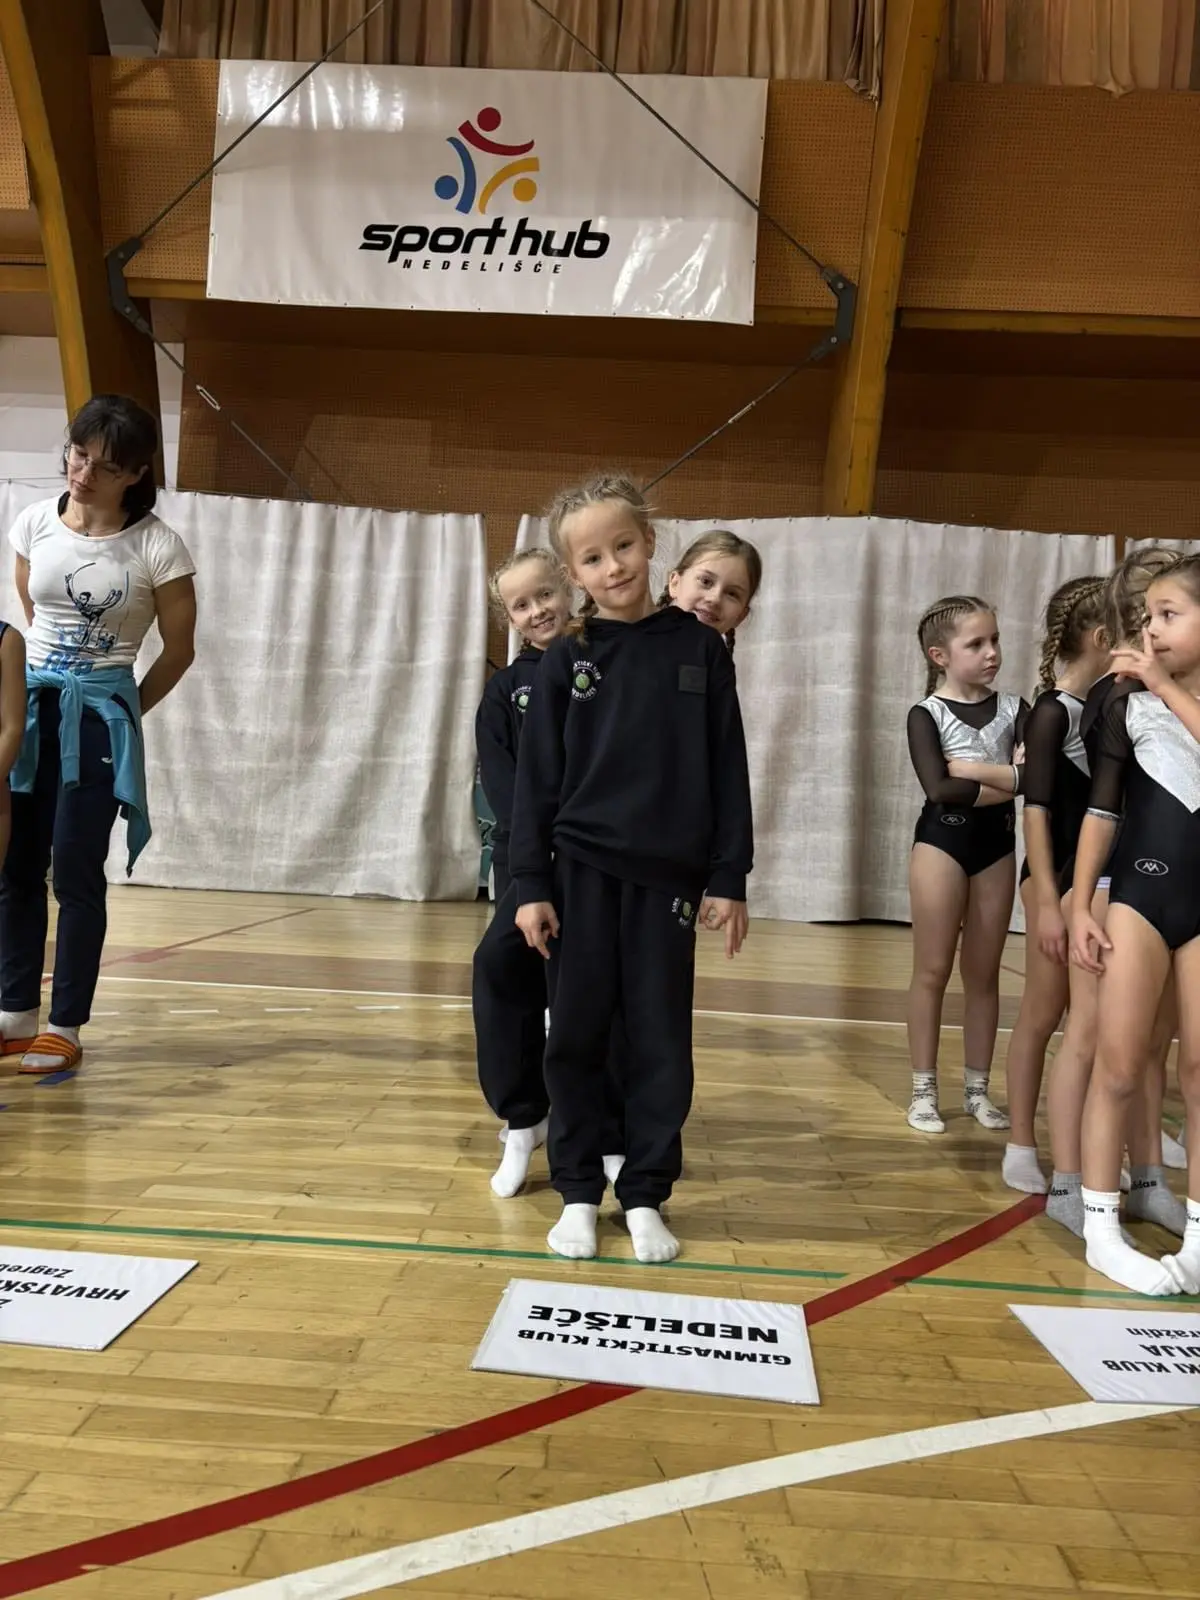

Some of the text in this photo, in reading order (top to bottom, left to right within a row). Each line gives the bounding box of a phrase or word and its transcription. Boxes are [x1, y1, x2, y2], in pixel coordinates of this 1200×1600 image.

[402, 259, 562, 274] NEDELIŠĆE
[0, 1280, 130, 1300] HRVATSK
[528, 1305, 779, 1344] NEDELIŠĆE
[1125, 1327, 1200, 1340] raždin
[517, 1329, 791, 1366] GIMNASTIČKI KLUB
[1102, 1360, 1200, 1374] KI KLUB
